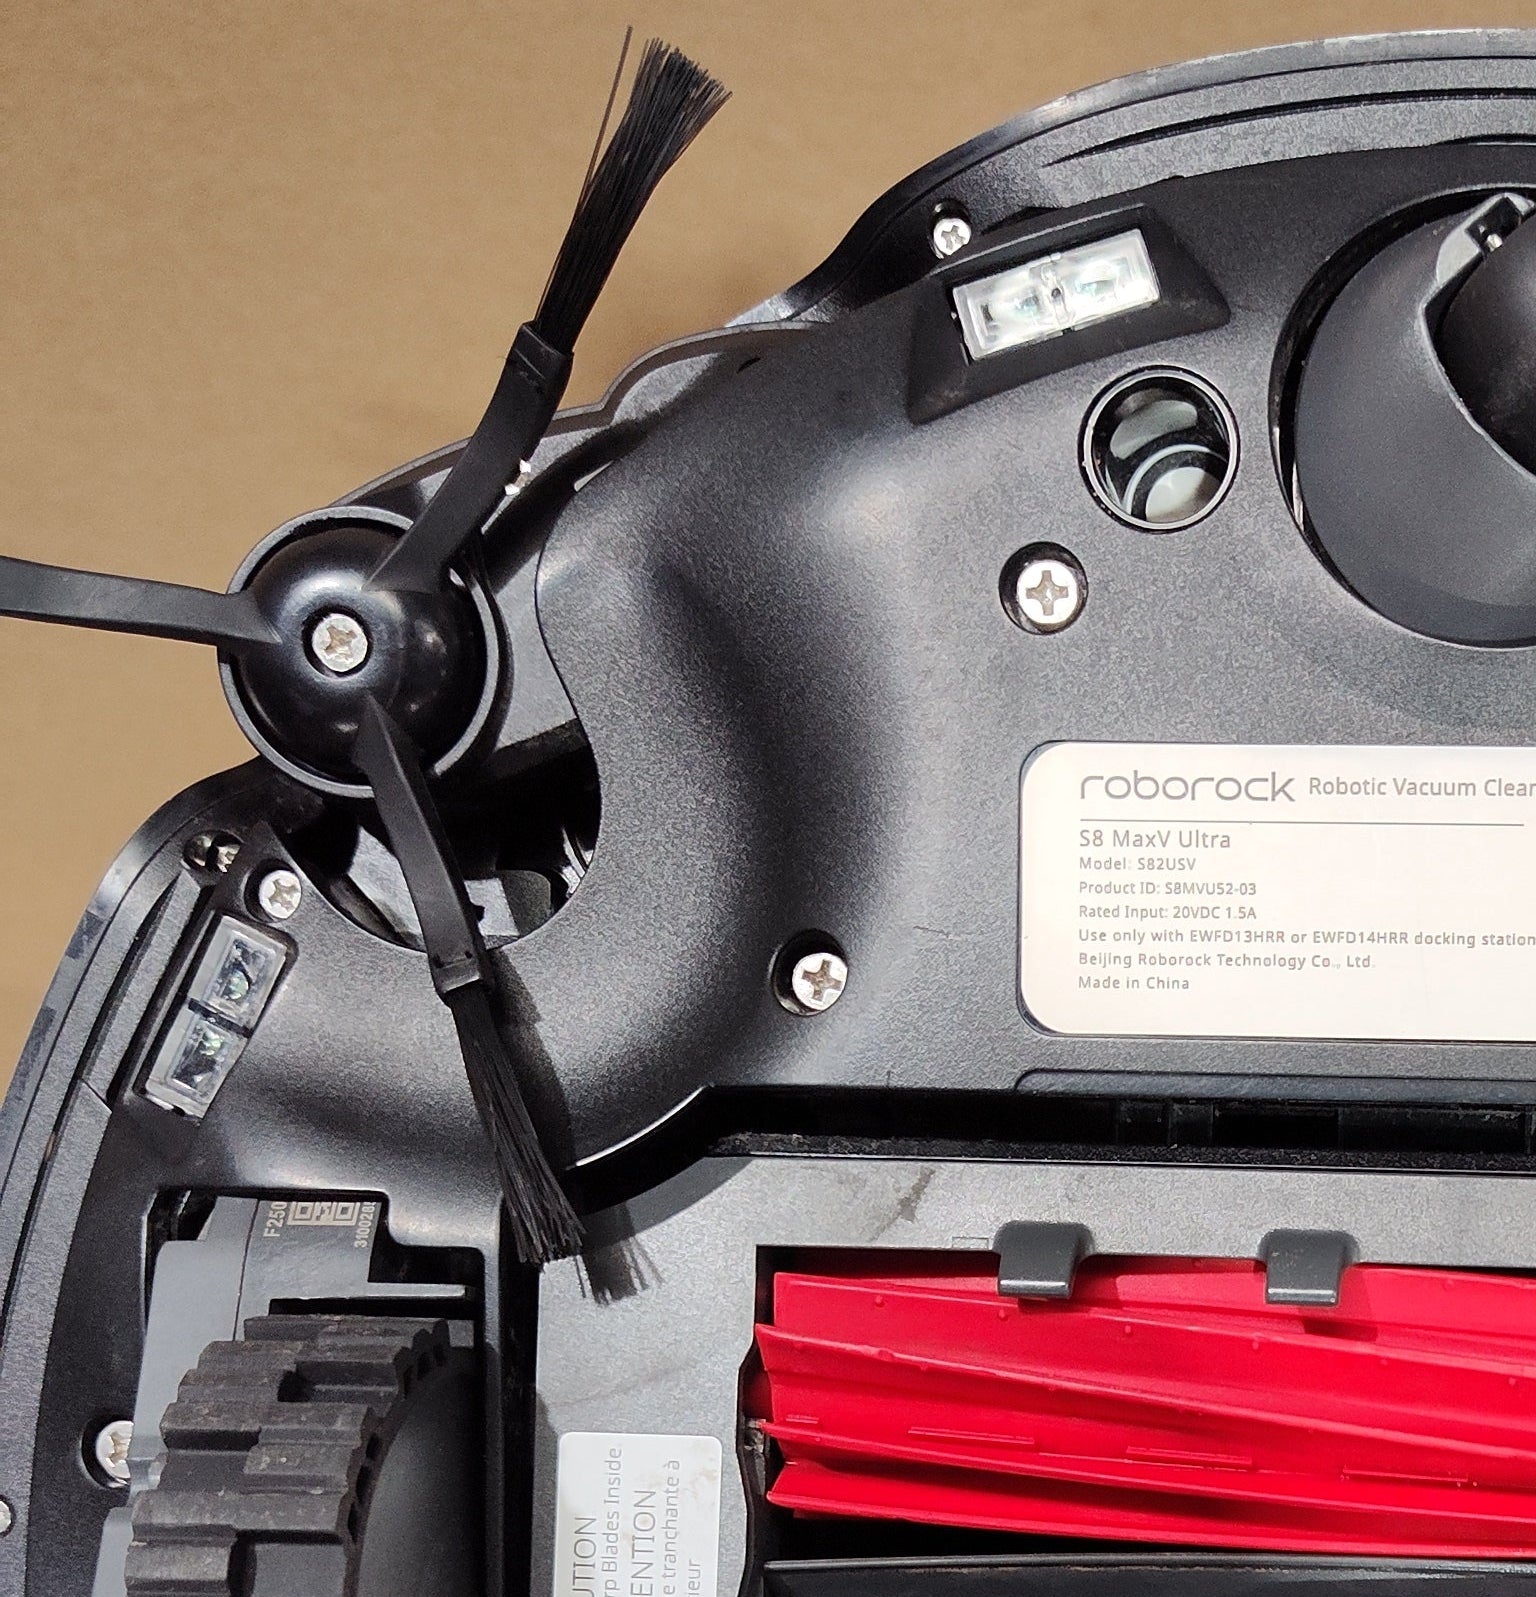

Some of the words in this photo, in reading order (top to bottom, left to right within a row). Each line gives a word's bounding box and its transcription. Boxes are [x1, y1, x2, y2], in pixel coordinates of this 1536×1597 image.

[1080, 769, 1295, 802] roborock
[1308, 776, 1387, 796] Robotic
[1393, 777, 1477, 797] Vacuum
[1079, 829, 1104, 847] S8
[1112, 830, 1171, 848] MaxV
[1178, 830, 1231, 849] Ultra
[1079, 856, 1131, 871] Model:
[1137, 857, 1197, 871] S82USV
[1079, 881, 1136, 895] Product
[1140, 881, 1160, 895] ID:
[1079, 905, 1120, 919] Rated
[1124, 905, 1168, 922] Input:
[1172, 906, 1221, 920] 20VDC
[1225, 907, 1257, 920] 1.5A
[1078, 929, 1107, 942] Use
[1112, 929, 1146, 946] only
[1150, 929, 1184, 943] with
[1189, 930, 1286, 944] EWFD13HRR
[1290, 933, 1308, 944] or
[1312, 931, 1409, 945] EWFD14HRR
[1414, 932, 1477, 949] docking
[1078, 953, 1133, 969] Beijing
[1138, 953, 1212, 967] Roborock
[1217, 954, 1306, 971] Technology
[1078, 976, 1121, 990] Made
[1126, 977, 1140, 990] in
[1146, 977, 1191, 990] China
[663, 1460, 681, 1470] à
[660, 1476, 680, 1579] tranchante
[600, 1510, 620, 1572] Blades
